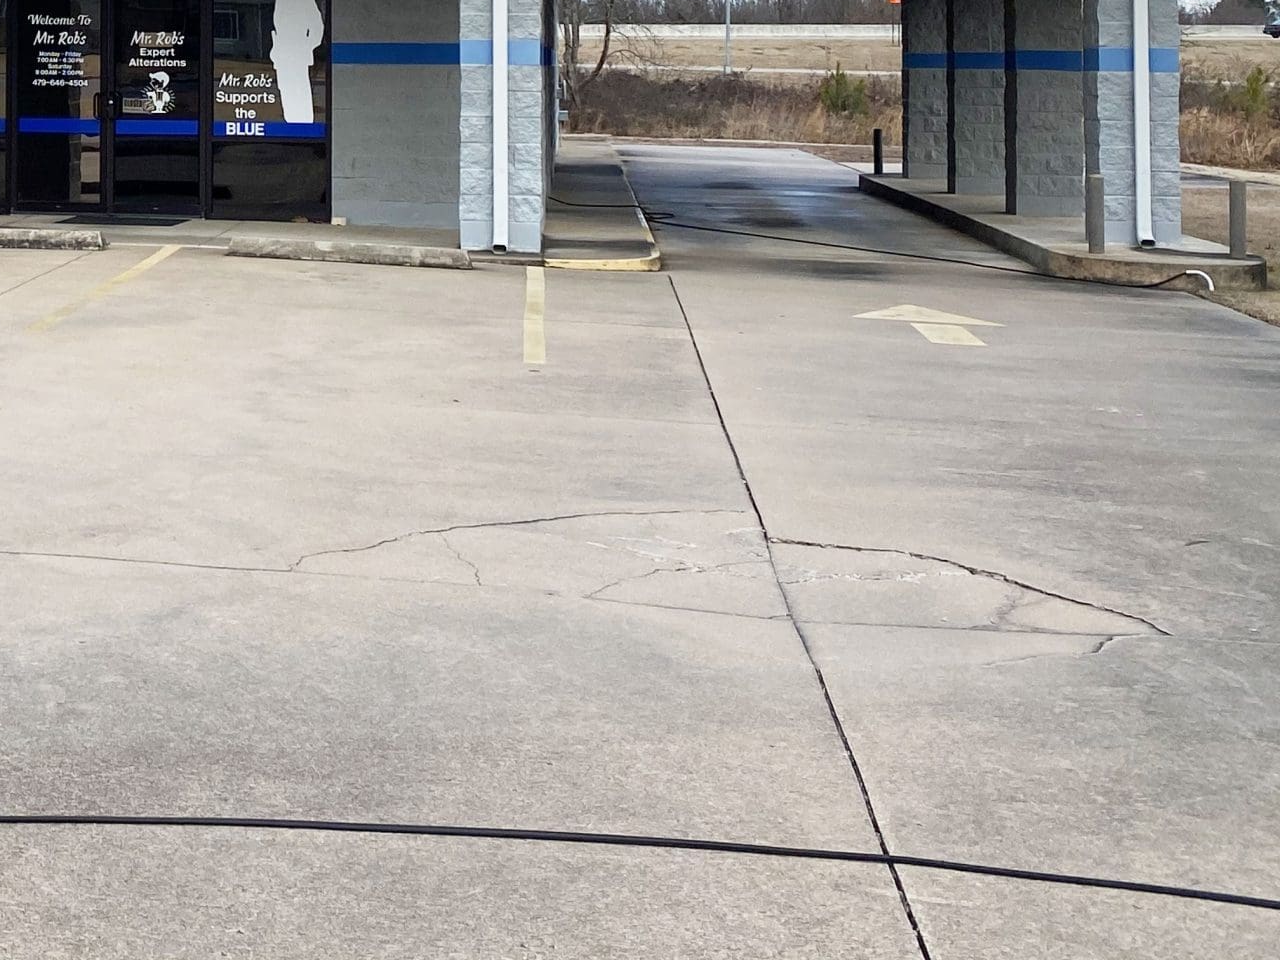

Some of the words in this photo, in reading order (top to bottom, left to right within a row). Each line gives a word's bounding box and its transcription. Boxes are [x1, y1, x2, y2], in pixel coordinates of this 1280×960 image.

[27, 14, 76, 25] Welcome
[77, 14, 92, 25] To
[33, 29, 55, 46] Mr.
[58, 30, 87, 45] Rob's
[130, 30, 152, 46] Mr.
[155, 30, 185, 46] Rob's
[139, 47, 175, 58] Expert
[128, 58, 187, 67] Alterations
[218, 72, 241, 88] Mr.
[243, 73, 273, 88] Rob's
[216, 91, 276, 105] Supports
[235, 107, 256, 119] the
[225, 121, 265, 136] BLUE
